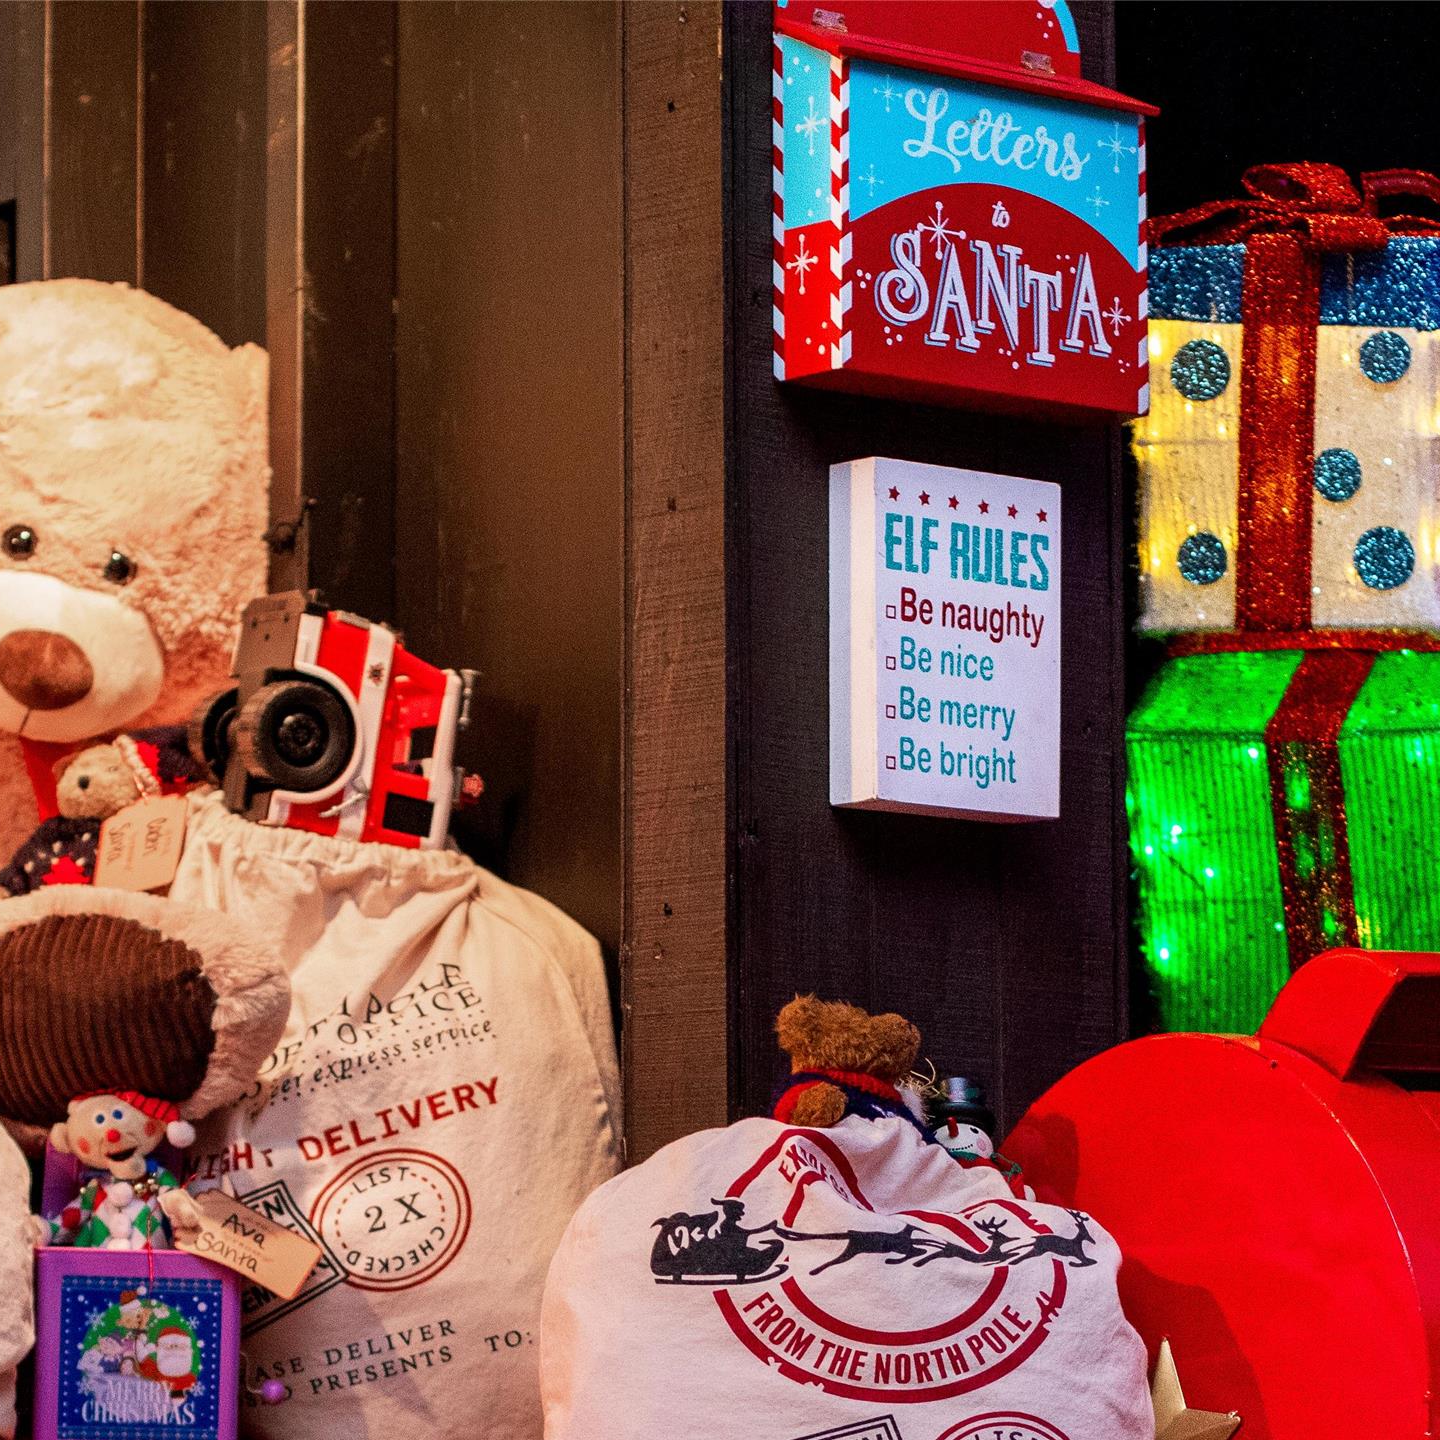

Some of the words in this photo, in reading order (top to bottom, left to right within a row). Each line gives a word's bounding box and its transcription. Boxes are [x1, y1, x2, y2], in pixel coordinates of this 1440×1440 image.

[903, 87, 1091, 181] Letters
[991, 202, 1010, 228] to
[874, 229, 1112, 366] SANTA
[884, 512, 939, 575] ELF
[950, 522, 1049, 591] RULES
[900, 586, 933, 624] Be
[942, 602, 1044, 648] naughty
[900, 636, 932, 673] Be
[940, 644, 994, 681] nice
[899, 686, 931, 722] Be
[939, 699, 1016, 741] merry
[899, 736, 931, 772] Be
[940, 741, 1017, 789] bright
[313, 1044, 402, 1082] express
[411, 1020, 494, 1052] service
[297, 1076, 499, 1162] DELIVERY
[353, 1166, 411, 1194] LIST
[221, 1213, 265, 1249] Ava
[346, 1225, 447, 1274] CHECKED
[311, 1345, 453, 1396] PRESENTS
[485, 1329, 535, 1354] TO:
[325, 1319, 456, 1366] DELIVER
[743, 1291, 816, 1361] FROM
[818, 1339, 867, 1382] THE
[873, 1344, 970, 1386] NORTH
[970, 1304, 1032, 1365] POLE
